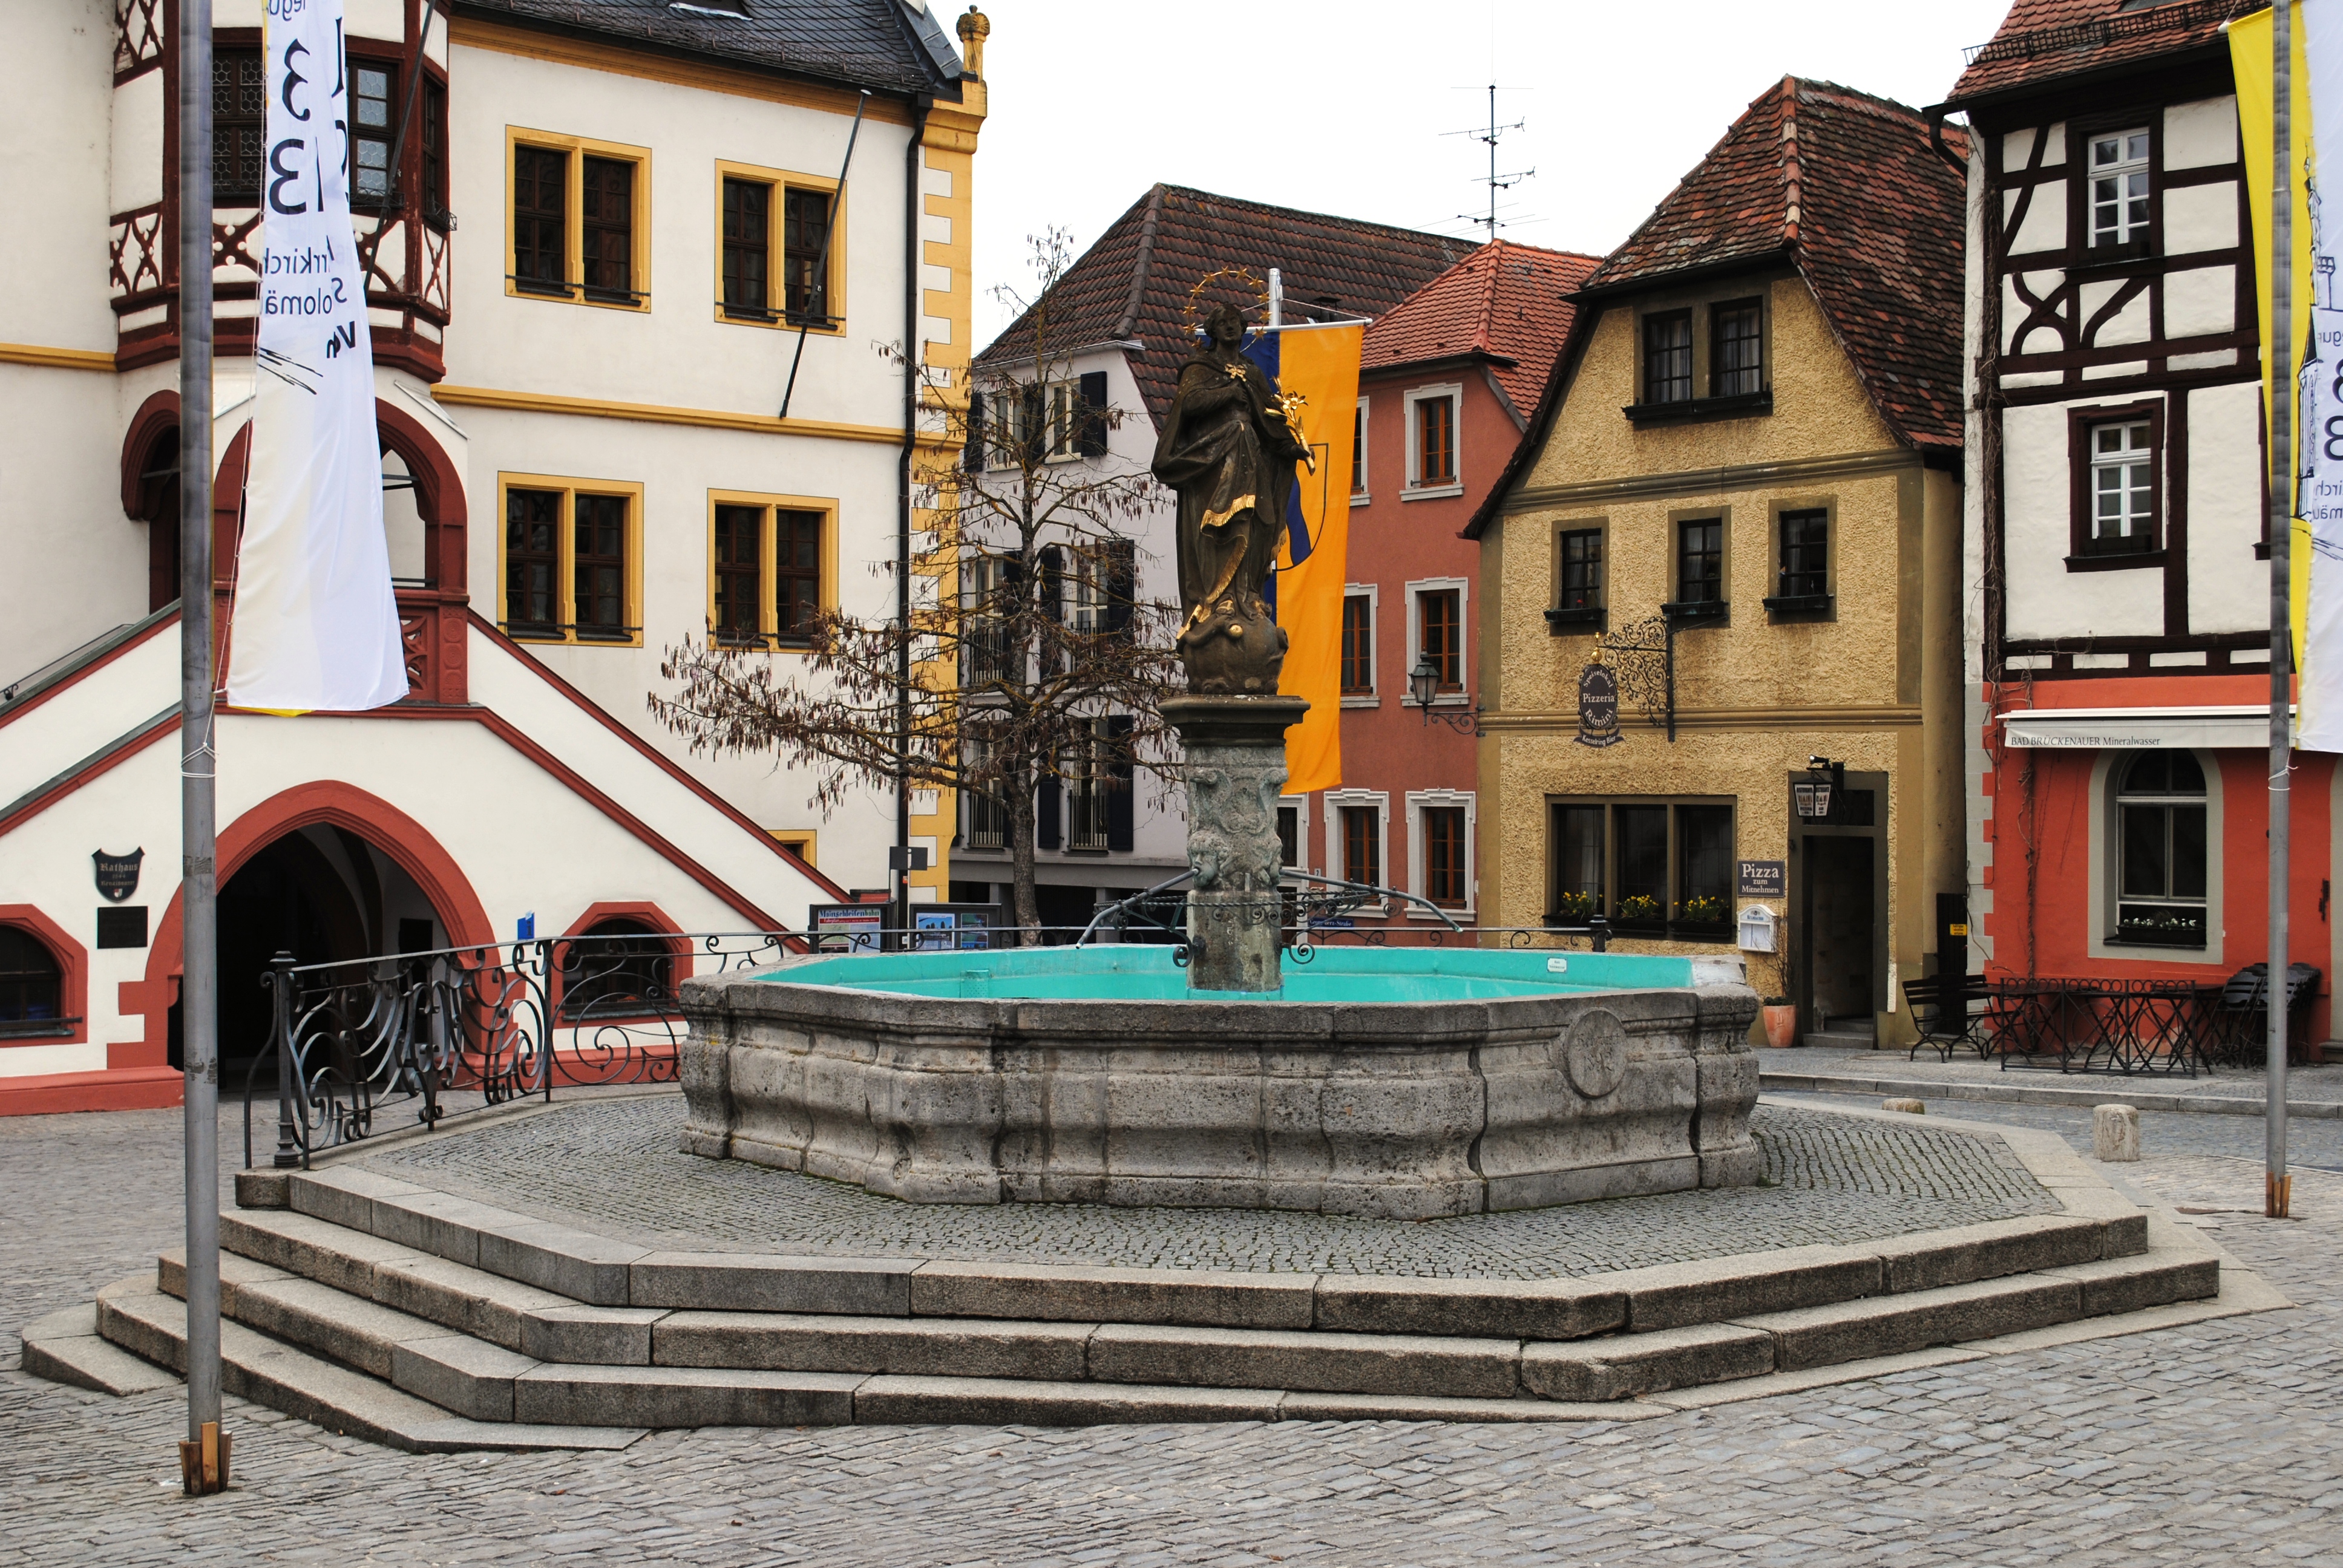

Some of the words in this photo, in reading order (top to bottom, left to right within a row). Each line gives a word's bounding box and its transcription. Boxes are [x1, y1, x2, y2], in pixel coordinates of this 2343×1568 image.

[1583, 669, 1613, 688] Speiselokal
[1582, 693, 1615, 702] Pizzeria
[1585, 708, 1613, 726] Rimini
[1582, 734, 1606, 746] Kesselring
[1606, 735, 1616, 743] Bier
[2011, 737, 2029, 746] BAD
[2031, 734, 2100, 746] BRÜCKENAUER
[2103, 736, 2161, 746] Mineralwasser
[100, 863, 138, 872] Rathaus
[1742, 863, 1779, 878] Pizza
[1742, 885, 1779, 893] Mitnehmen
